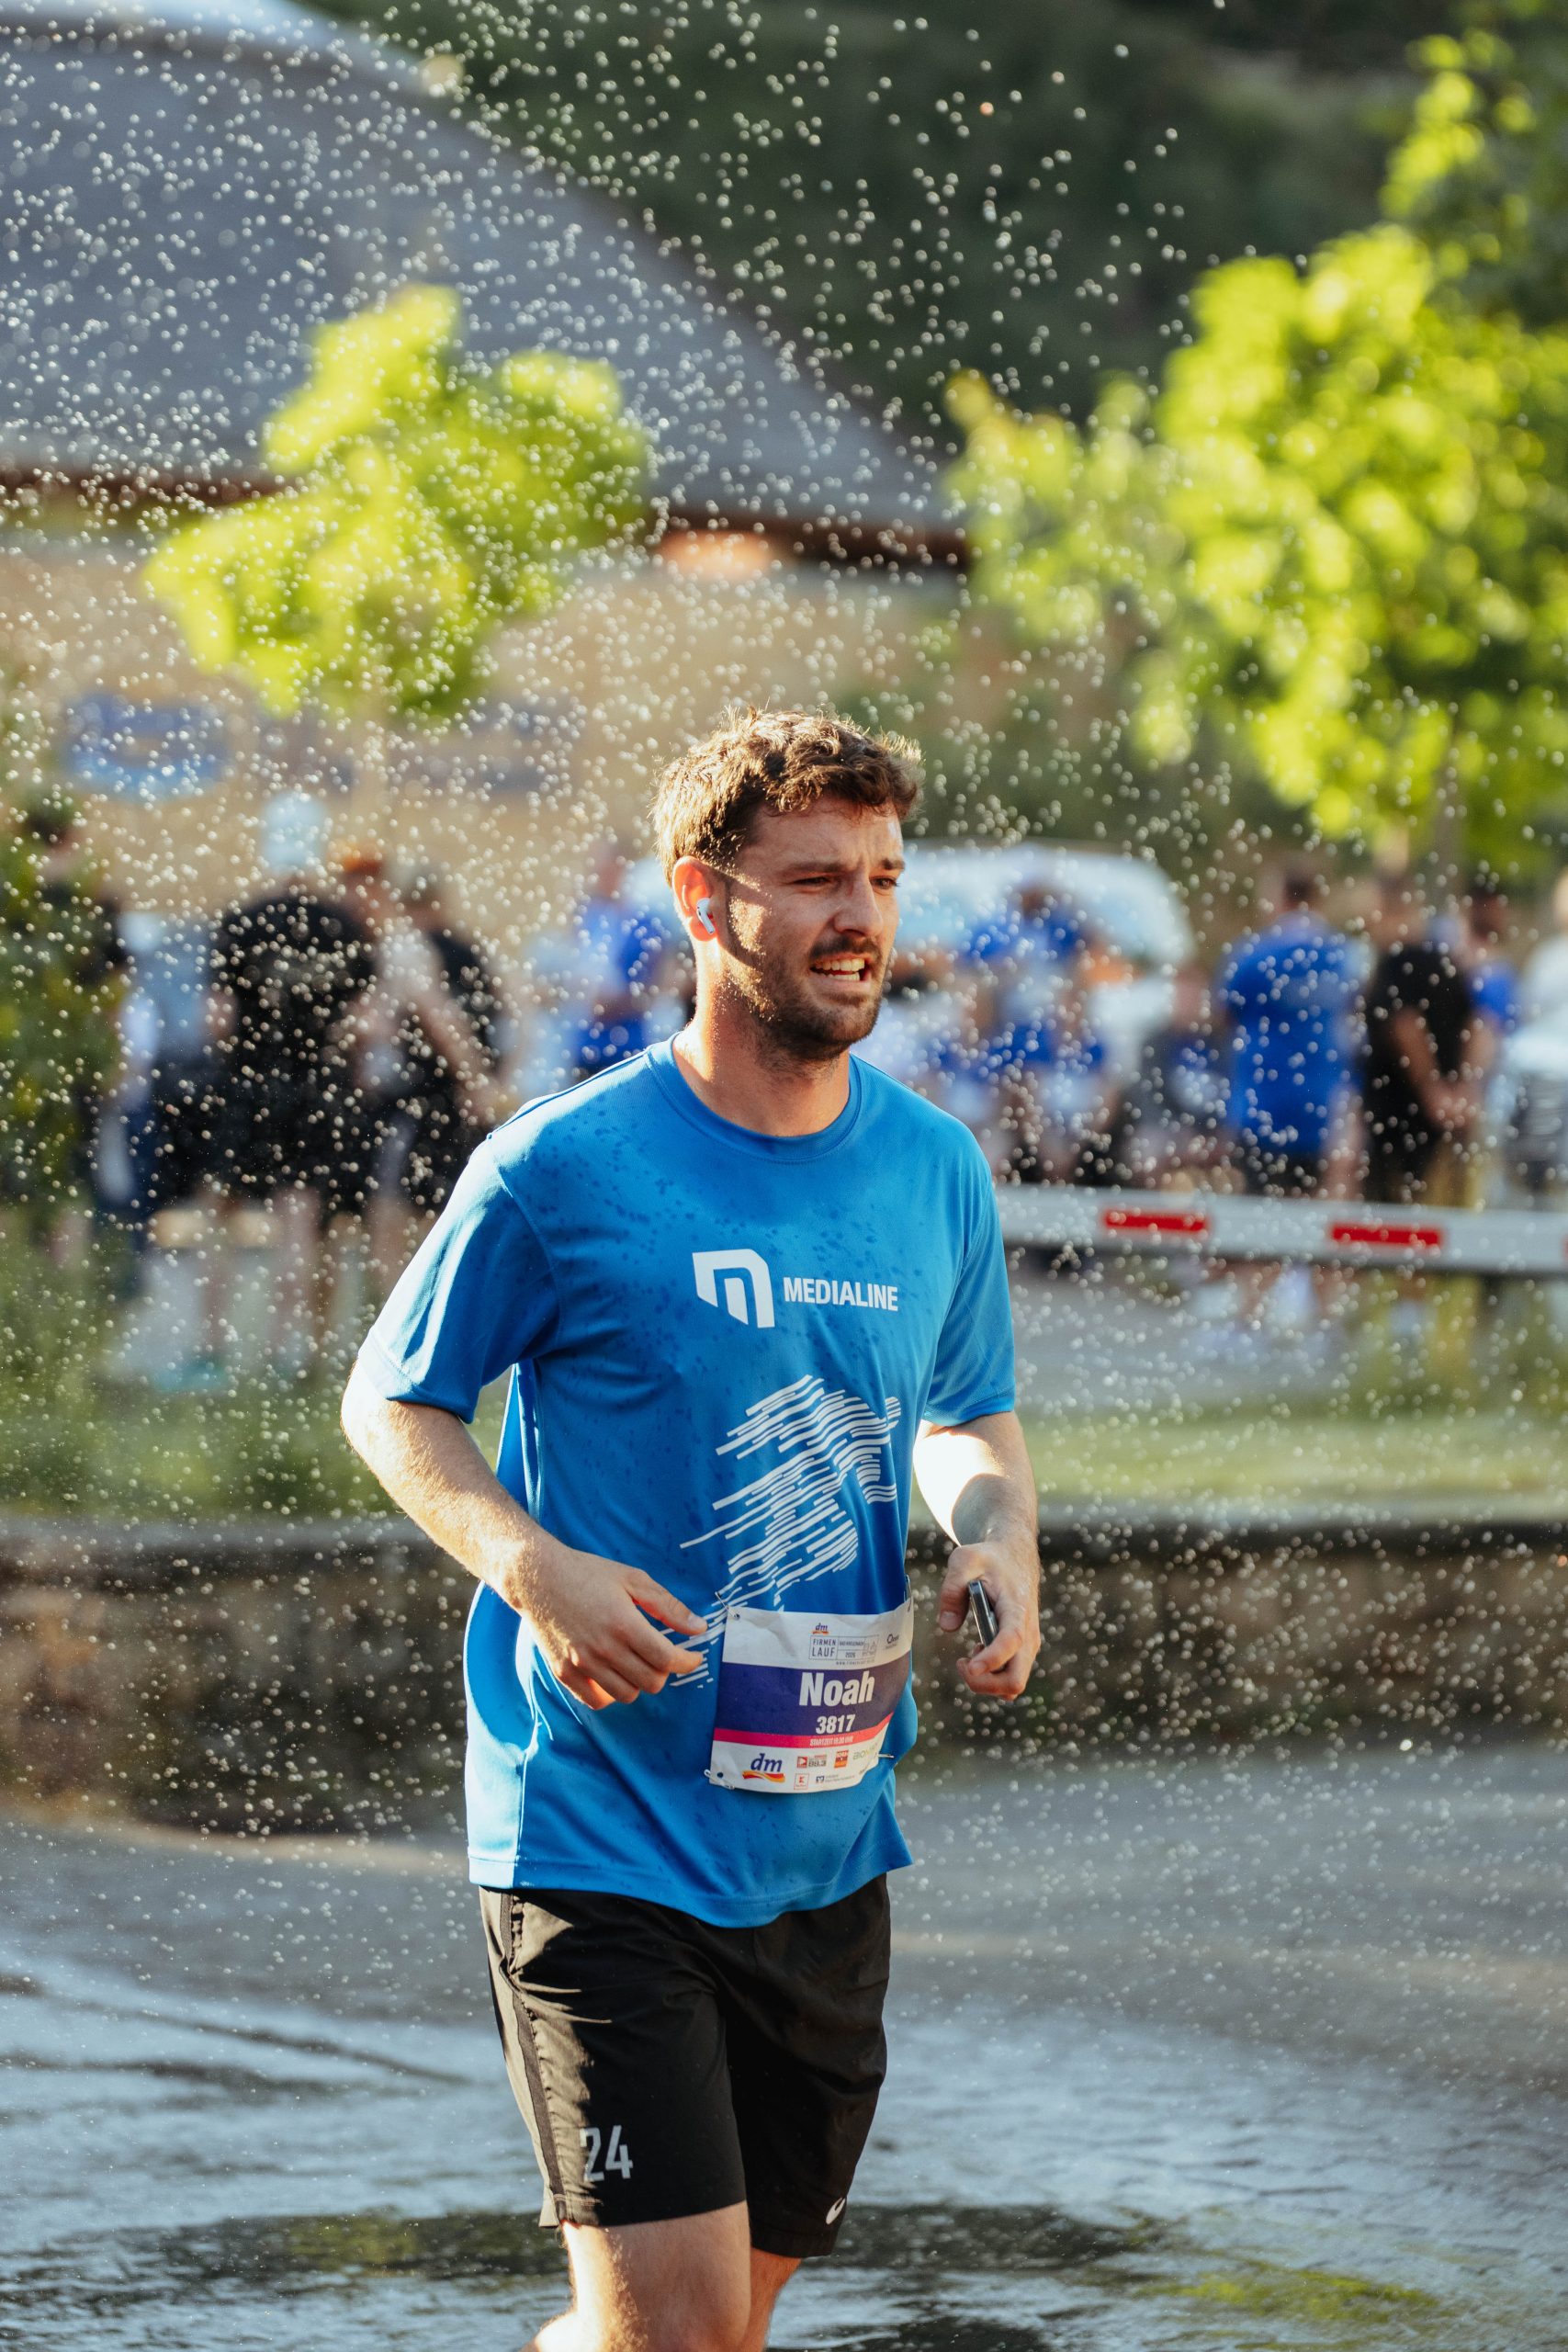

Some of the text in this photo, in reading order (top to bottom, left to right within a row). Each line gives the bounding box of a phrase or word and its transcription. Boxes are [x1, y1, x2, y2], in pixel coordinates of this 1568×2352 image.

[784, 1277, 898, 1312] MEDIALINE
[812, 1646, 835, 1657] LAUF
[813, 1638, 836, 1646] FIRMEN
[799, 1670, 875, 1707] Noah
[816, 1714, 855, 1735] 3817
[750, 1752, 783, 1772] dm
[581, 2124, 634, 2183] 24
